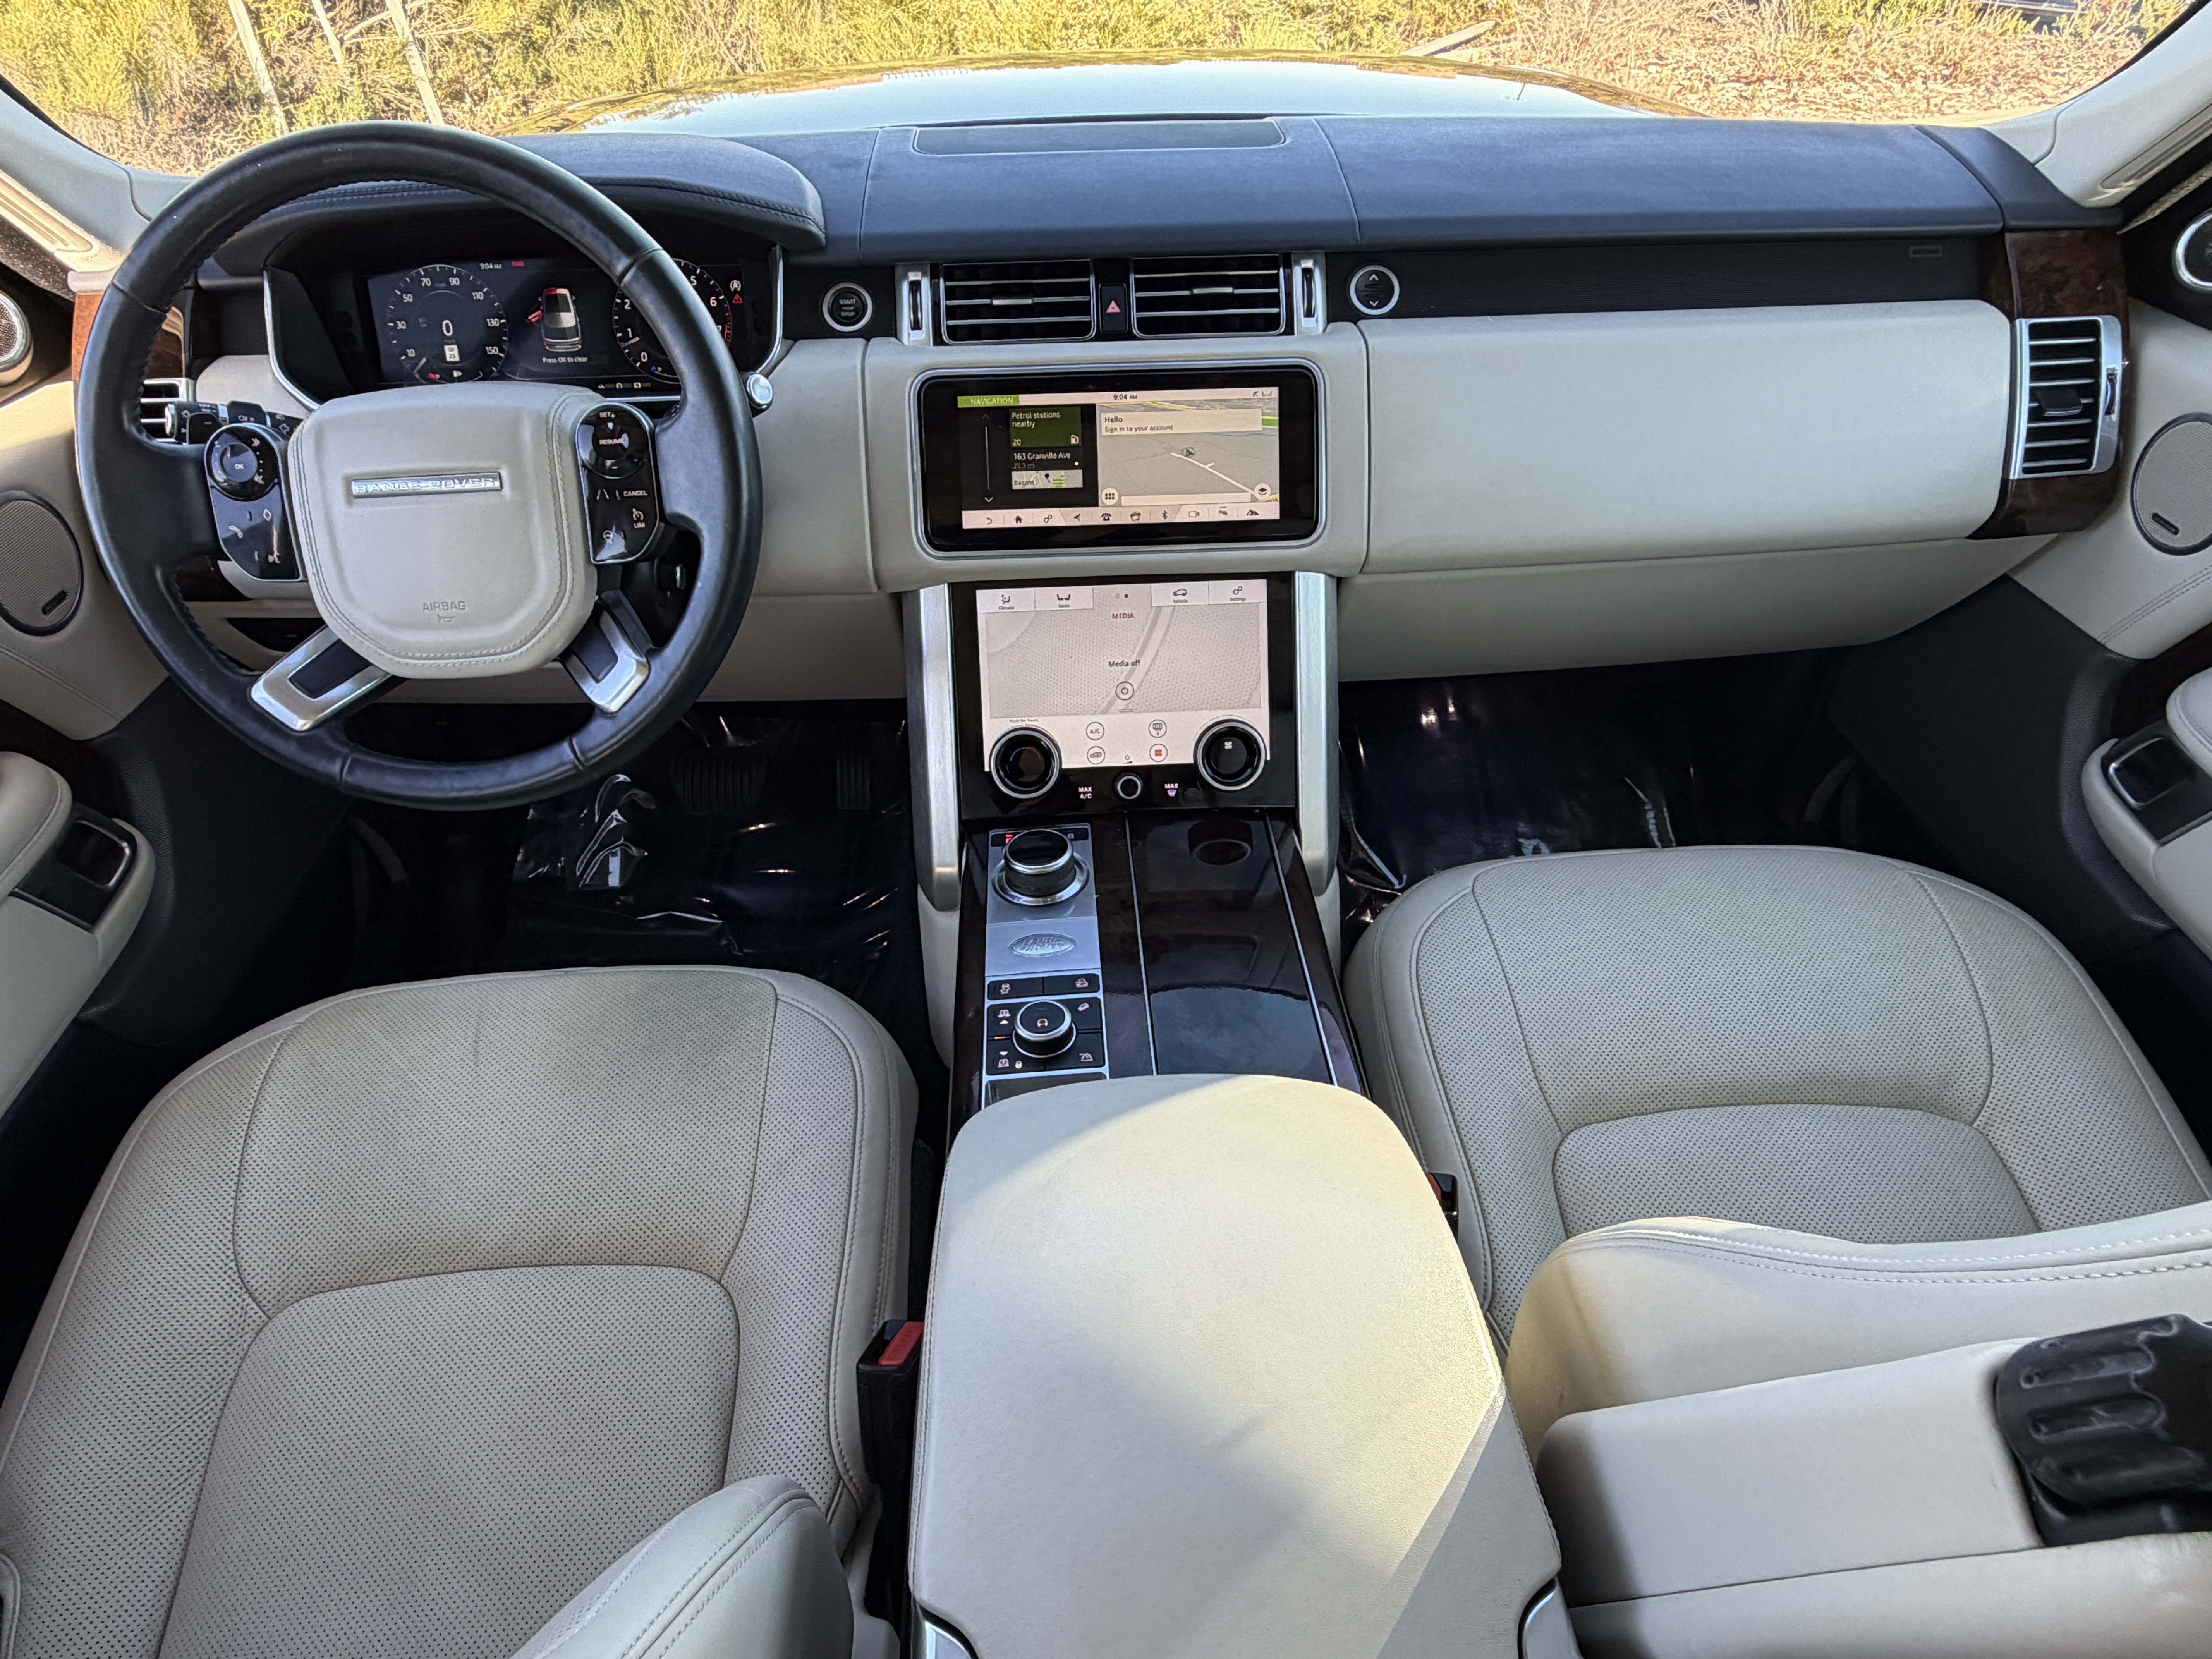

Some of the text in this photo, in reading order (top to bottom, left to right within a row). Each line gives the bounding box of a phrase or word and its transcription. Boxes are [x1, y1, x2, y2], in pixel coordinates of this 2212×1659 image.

[421, 278, 431, 287] 70
[449, 277, 460, 285] 90
[690, 276, 697, 285] 5
[403, 294, 413, 302] 50
[472, 292, 484, 300] 110
[624, 299, 631, 310] 2
[710, 297, 716, 307] 6
[396, 321, 406, 329] 30
[487, 318, 499, 327] 130
[442, 320, 453, 336] 0
[627, 328, 632, 338] 1
[486, 346, 499, 355] 150
[640, 352, 648, 362] 0
[970, 397, 1013, 405] NAVIGATION
[1012, 420, 1036, 428] nearby
[423, 601, 466, 611] AIRBAG
